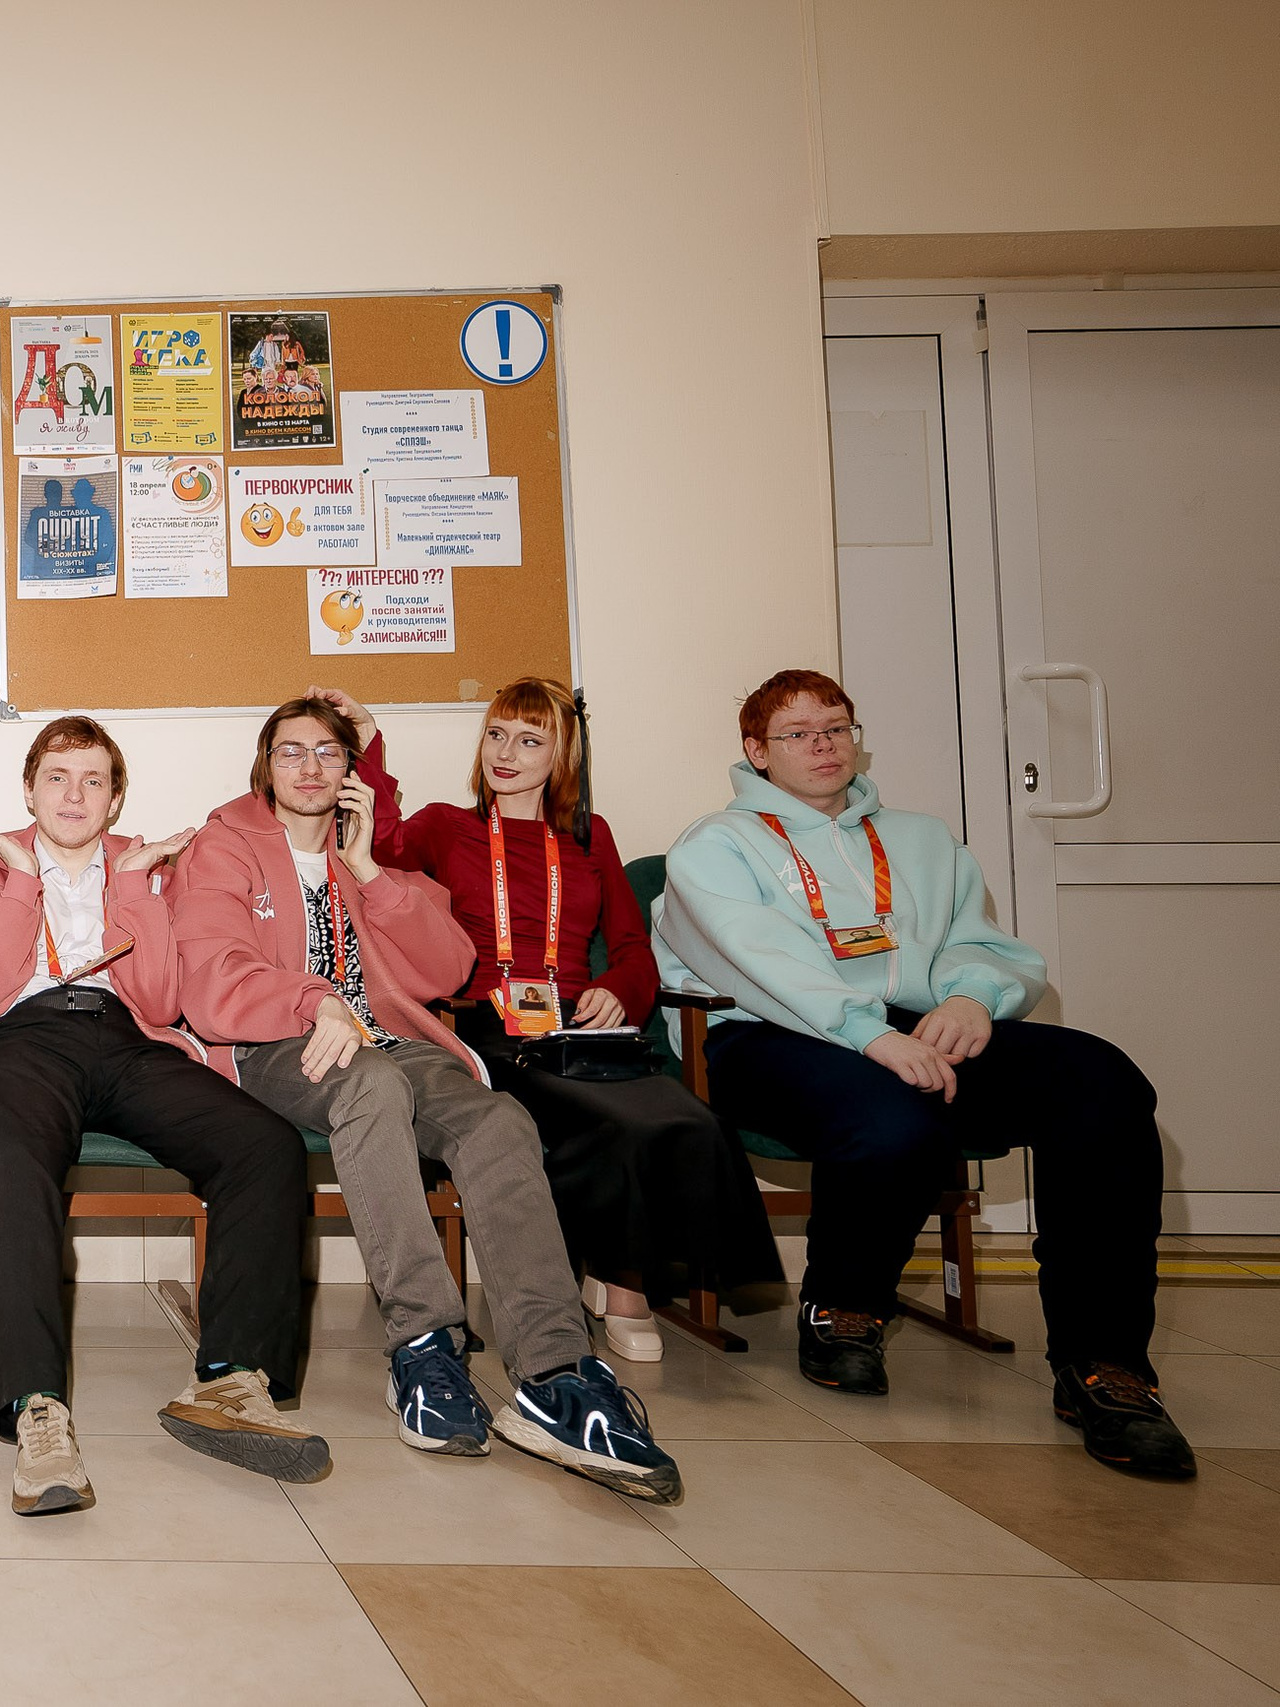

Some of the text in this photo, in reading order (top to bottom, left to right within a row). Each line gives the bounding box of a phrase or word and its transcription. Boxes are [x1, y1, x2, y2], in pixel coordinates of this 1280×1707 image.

[243, 391, 321, 405] КОЛОКОЛ
[241, 403, 324, 419] НАДЕЖДЫ
[362, 424, 464, 435] Студия современного танца
[395, 437, 431, 447] «СПЛЭШ»
[129, 464, 143, 473] РМИ
[139, 482, 166, 490] апреля
[245, 478, 354, 495] ПЕРВОКУРСНИК
[384, 491, 509, 504] Творческое объединение «МАЯК»
[49, 509, 91, 517] ВЫСТАВКА
[313, 505, 353, 516] ДЛЯ ТЕБЯ
[131, 521, 189, 529] «СЧАСТЛИВЫЕ
[313, 524, 345, 532] актовом
[346, 523, 365, 531] зале
[38, 516, 101, 554] СУРГУТ
[397, 531, 501, 542] Маленький студенческий театр
[318, 538, 359, 549] РАБОТАЮТ
[51, 549, 95, 558] сюжетах:
[424, 544, 474, 556] «ДИЛИЖАНС»
[55, 559, 85, 567] ВИЗИТЫ
[318, 568, 445, 587] ??? ИНТЕРЕСНО ???
[385, 595, 429, 605] Подходи
[371, 604, 445, 616] после занятий
[368, 616, 447, 628] к руководителям
[360, 629, 447, 643] ЗАПИСЫВАЙСЯ!!!
[332, 881, 344, 959] СТУДВЕСНА
